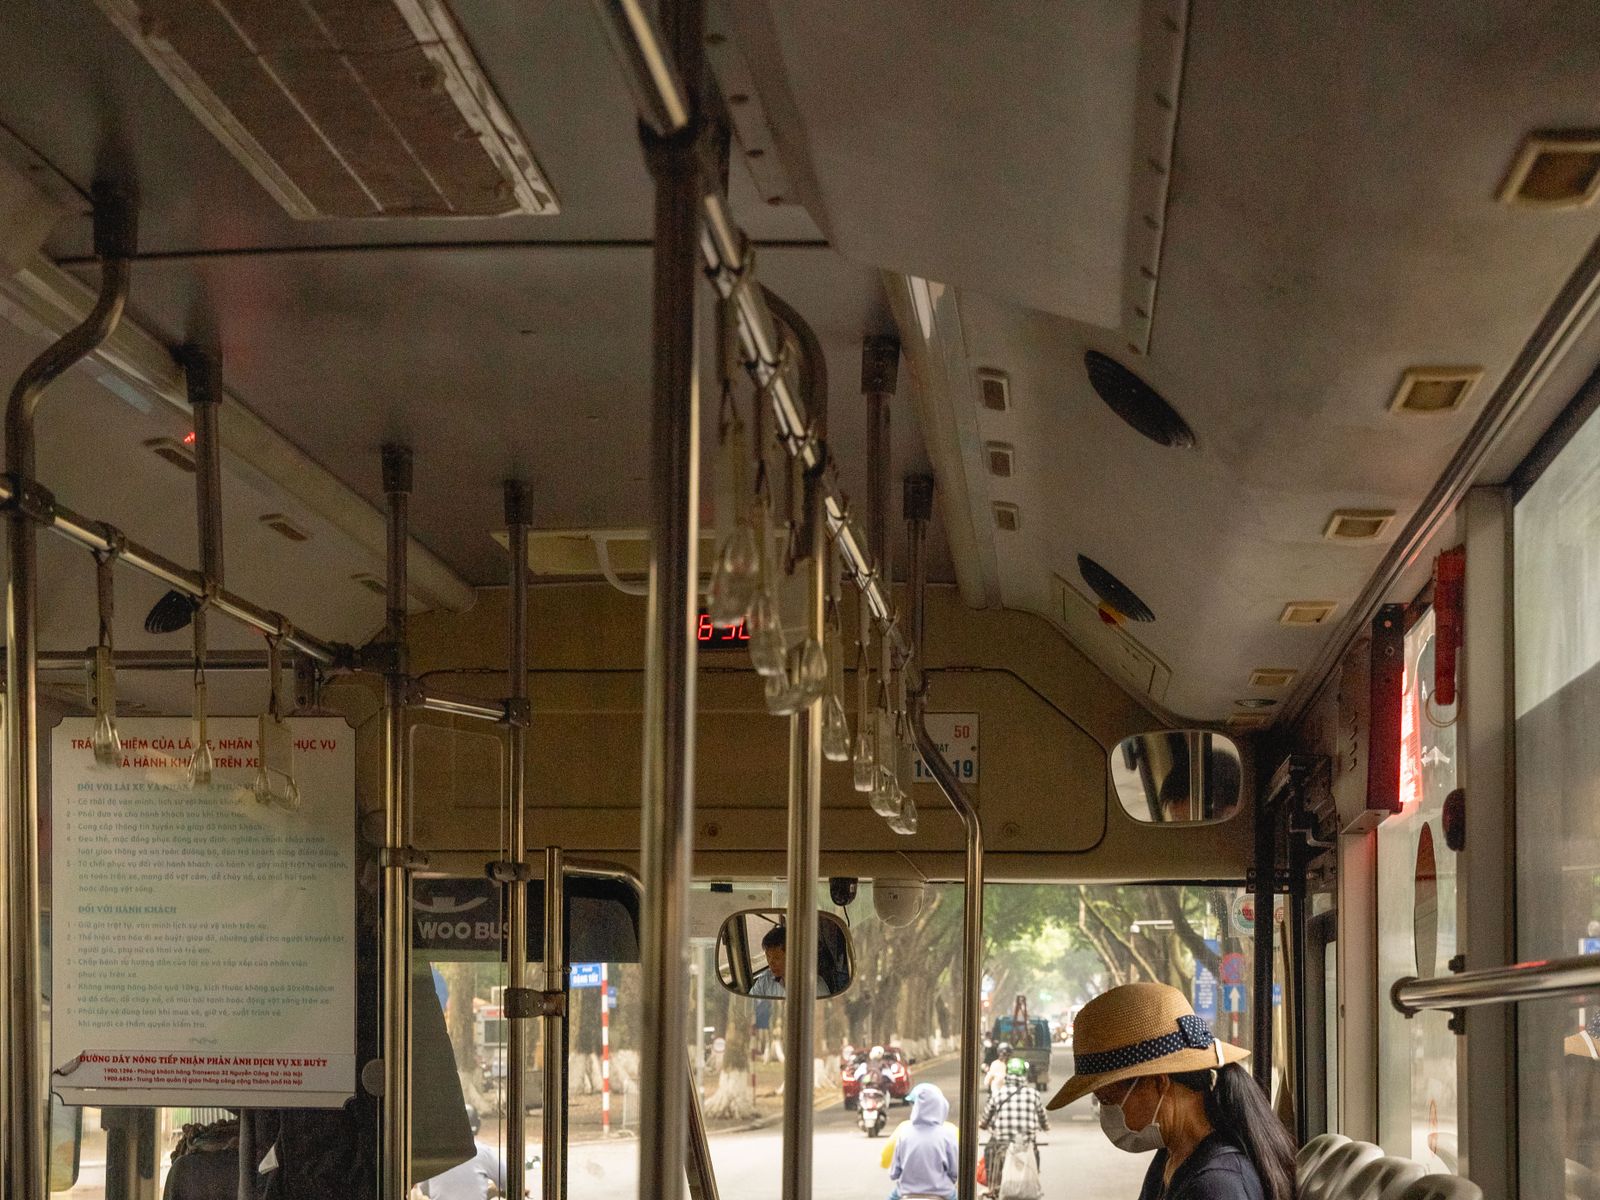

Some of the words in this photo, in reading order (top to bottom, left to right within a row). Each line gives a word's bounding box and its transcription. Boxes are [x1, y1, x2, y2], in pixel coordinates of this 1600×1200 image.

[954, 725, 970, 738] 50
[119, 737, 149, 751] HIỆM
[152, 735, 175, 750] CỦA
[178, 737, 192, 750] LÁ
[219, 737, 253, 750] NHÂN
[320, 739, 337, 753] VỤ
[133, 754, 168, 768] HÀNH
[213, 755, 242, 768] TRÊN
[245, 757, 260, 768] XE
[418, 921, 472, 940] WOO
[80, 1054, 110, 1063] ĐƯỜNG
[112, 1054, 130, 1064] DÂY
[132, 1054, 157, 1064] NÓNG
[159, 1053, 178, 1065] TIẾP
[180, 1055, 205, 1067] NHẬN
[206, 1055, 231, 1066] PHẢN
[233, 1056, 252, 1066] ẢNH
[253, 1058, 275, 1068] DỊCH
[276, 1058, 289, 1068] VỤ
[290, 1059, 302, 1067] XE
[304, 1057, 328, 1068] BUÝT
